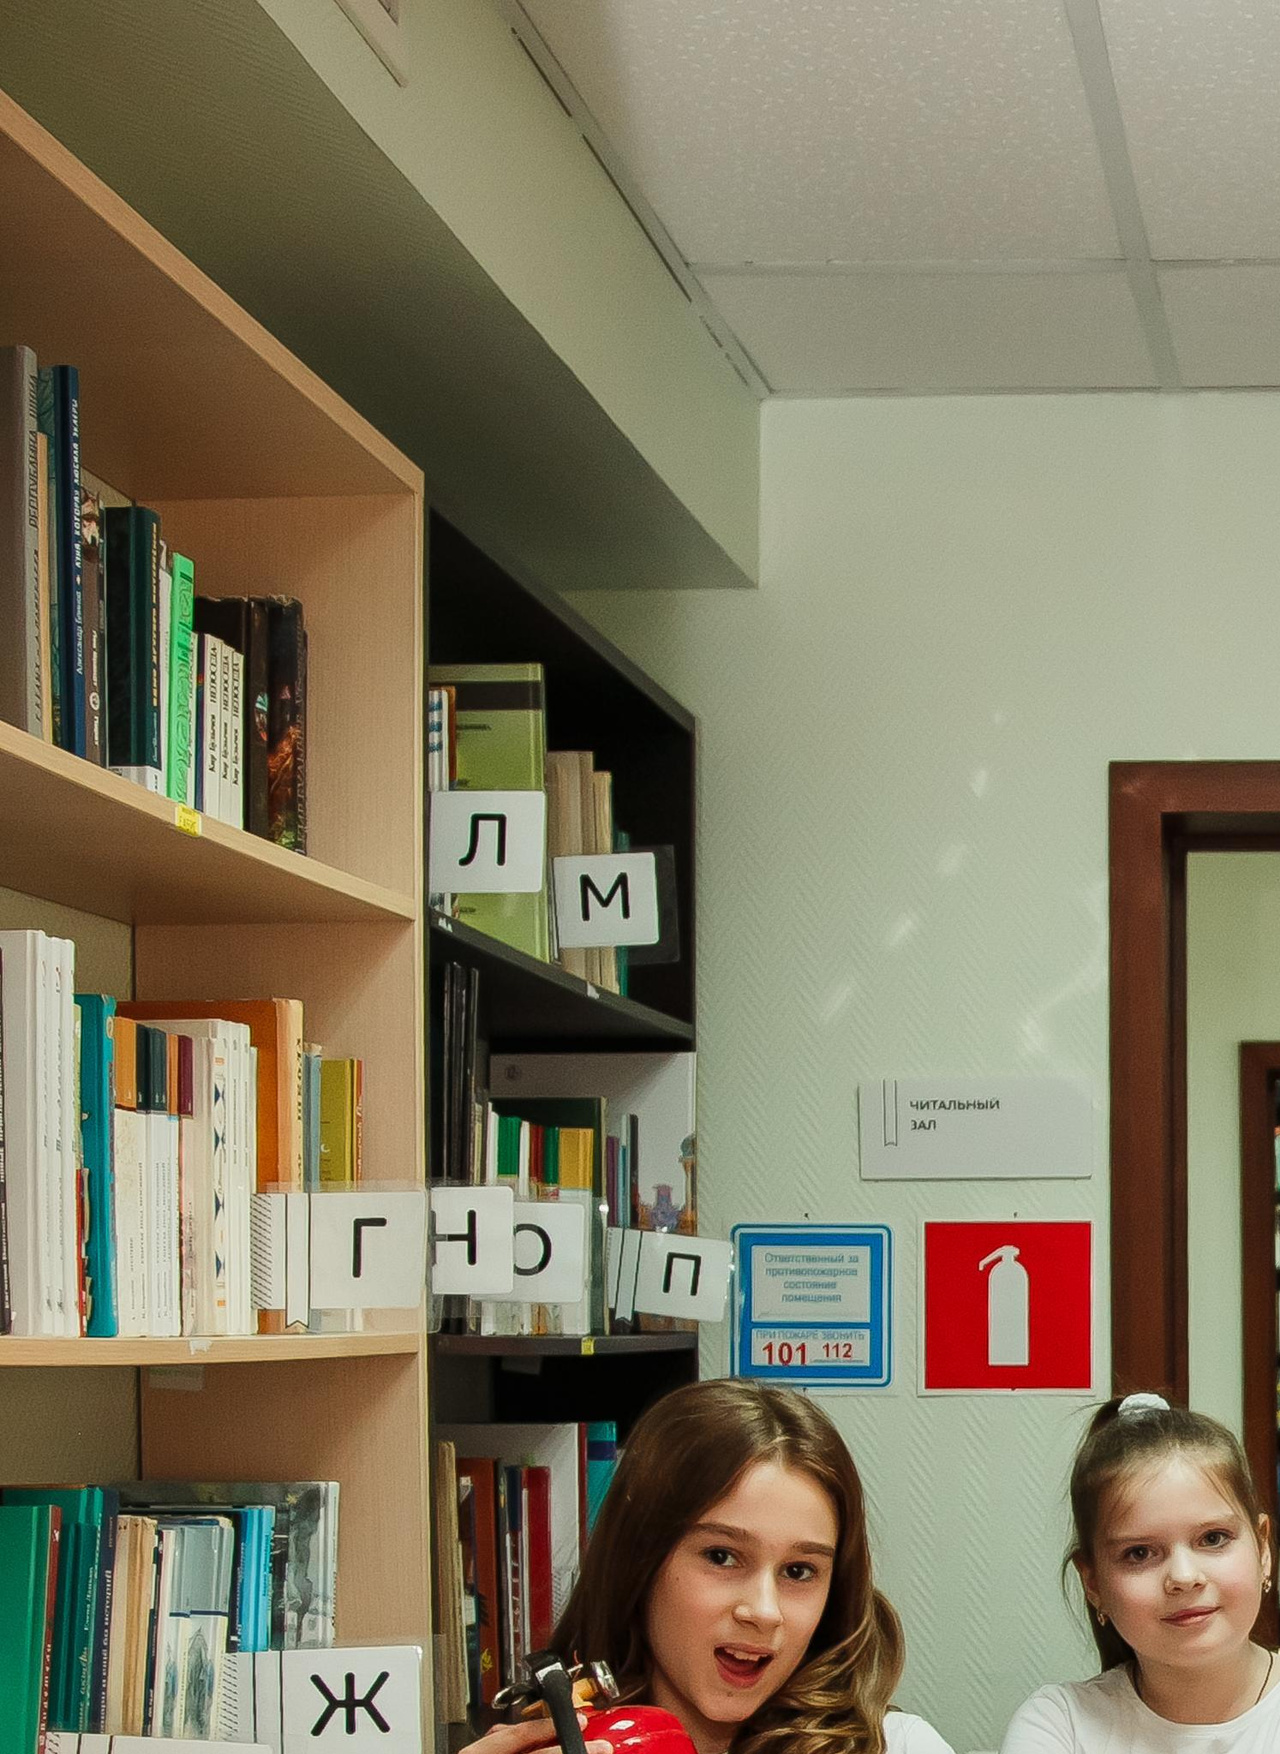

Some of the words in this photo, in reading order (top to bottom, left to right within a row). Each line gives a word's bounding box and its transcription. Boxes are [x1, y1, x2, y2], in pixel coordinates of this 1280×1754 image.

[457, 812, 507, 867] Л
[579, 871, 631, 922] М
[909, 1097, 1001, 1111] ЧИТАЛЬНЫЙ
[910, 1119, 937, 1131] ЗАЛ
[352, 1217, 387, 1279] Г
[764, 1252, 845, 1263] Ответственный
[663, 1251, 701, 1297] П
[765, 1268, 858, 1278] противопожарное
[783, 1281, 837, 1290] состояние
[781, 1294, 842, 1303] помещения
[755, 1330, 776, 1340] ПРИ
[778, 1330, 818, 1340] ПОЖАРЕ
[822, 1330, 865, 1340] ЗВОНИТЬ
[762, 1341, 807, 1366] 101
[822, 1342, 853, 1359] 112
[309, 1669, 391, 1736] Ж
